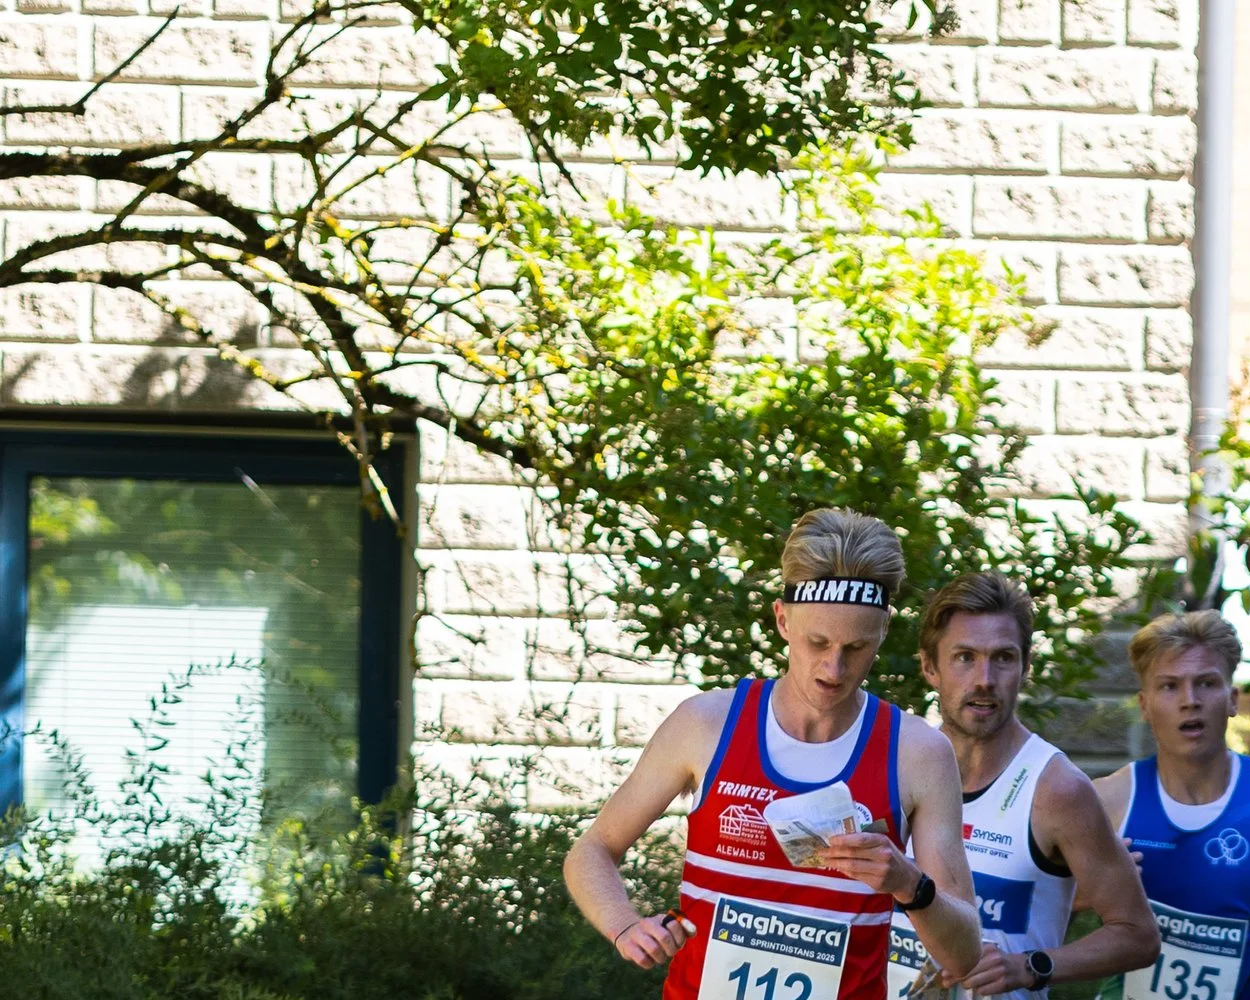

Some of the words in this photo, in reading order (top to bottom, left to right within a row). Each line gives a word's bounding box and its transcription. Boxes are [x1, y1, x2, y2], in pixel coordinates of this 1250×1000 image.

[794, 580, 883, 605] TRIMTEX
[717, 781, 778, 802] TRIMTEX
[716, 844, 766, 860] ALEWALDS
[722, 905, 841, 947] bagheera
[1152, 912, 1242, 942] agheera
[731, 934, 745, 943] SM
[750, 938, 815, 958] SPRINTDISTANS
[816, 952, 835, 962] 2025
